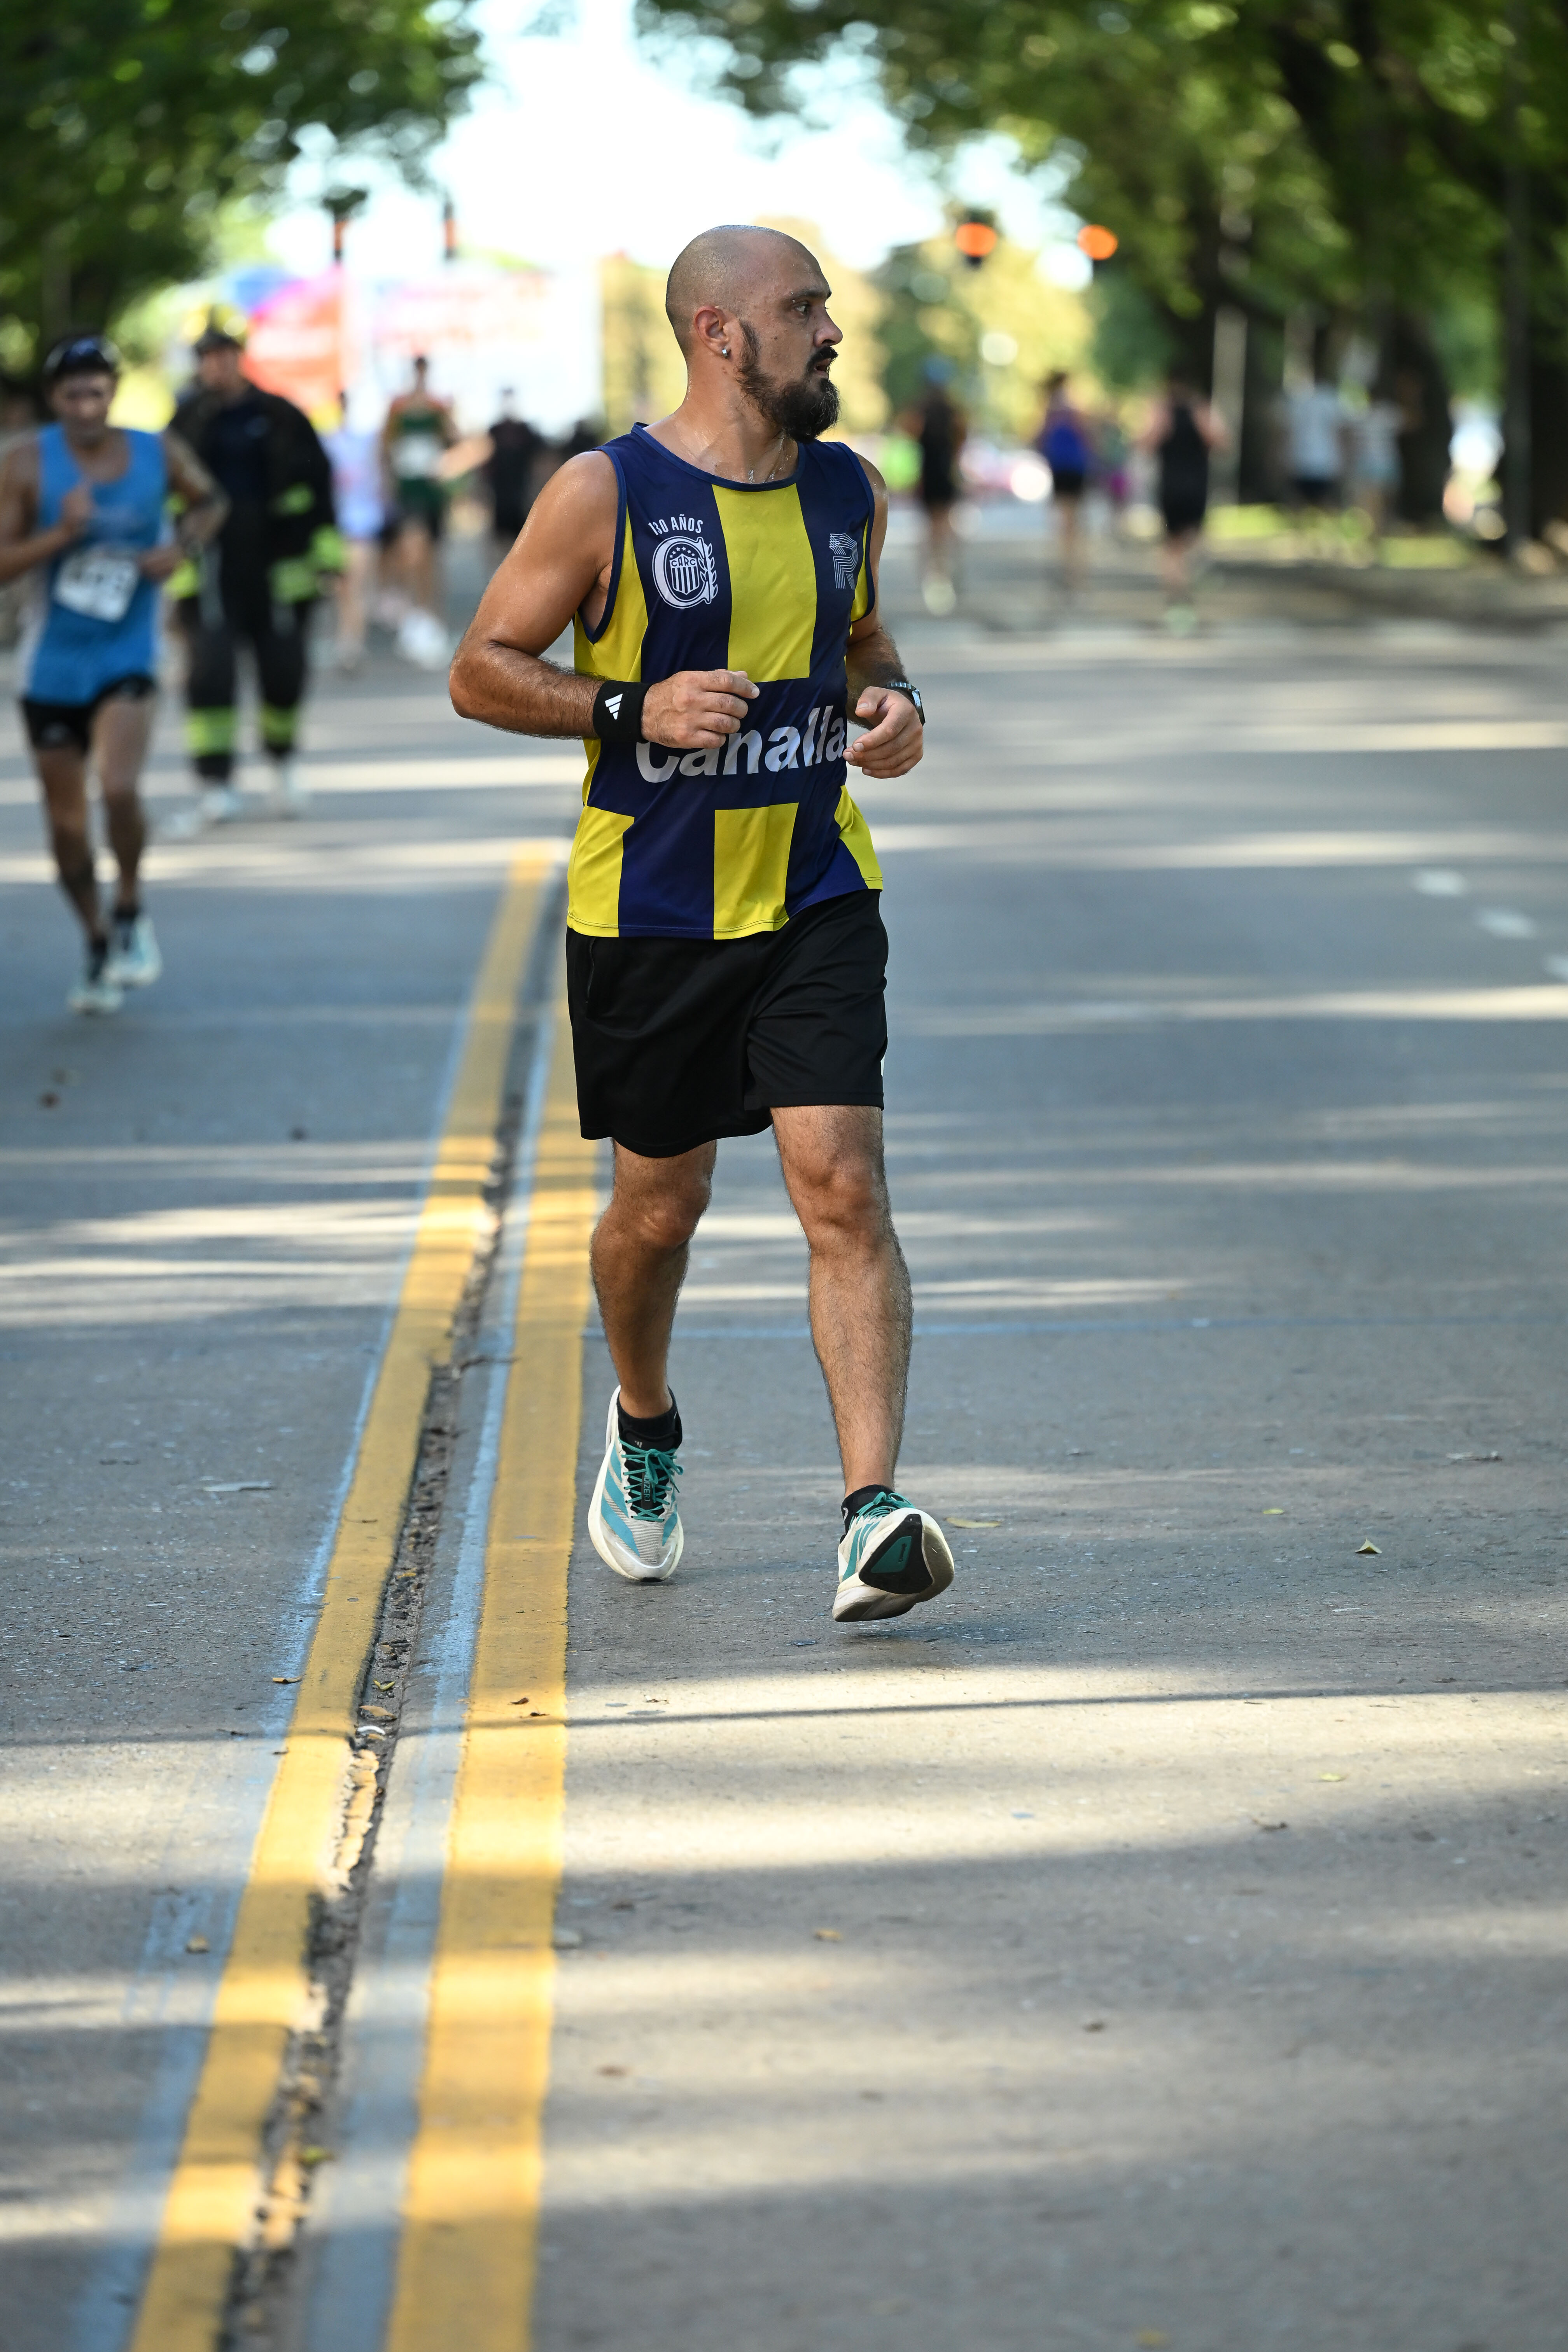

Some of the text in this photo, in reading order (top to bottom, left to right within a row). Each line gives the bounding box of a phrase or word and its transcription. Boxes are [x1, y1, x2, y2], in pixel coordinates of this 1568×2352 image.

[648, 514, 703, 536] 130 AÑOS
[671, 557, 696, 567] CARC
[636, 705, 844, 783] Canalla
